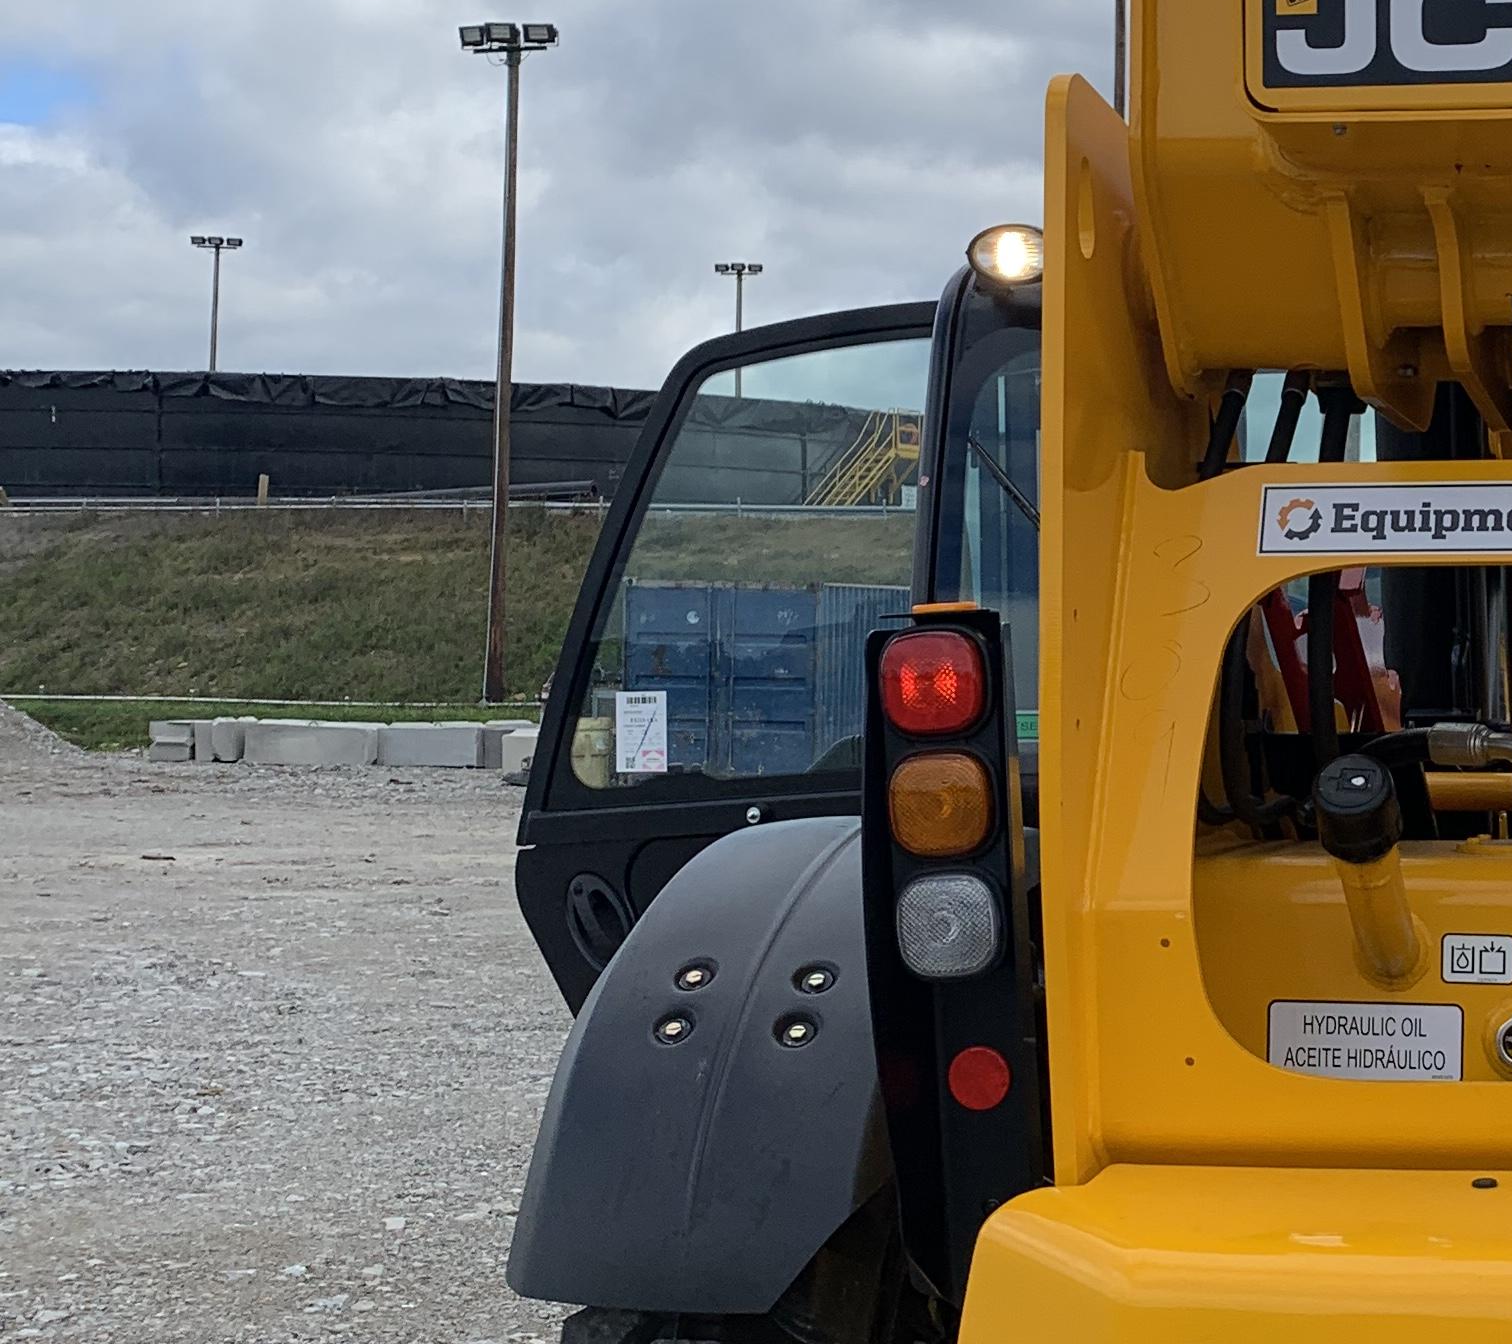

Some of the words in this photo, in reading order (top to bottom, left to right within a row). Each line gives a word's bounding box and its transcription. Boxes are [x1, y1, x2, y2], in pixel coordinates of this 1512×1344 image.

[1302, 1014, 1397, 1037] HYDRAULIC
[1401, 1017, 1428, 1038] OIL
[1283, 1046, 1342, 1068] ACEITE
[1347, 1044, 1446, 1071] HIDRÁULICO
